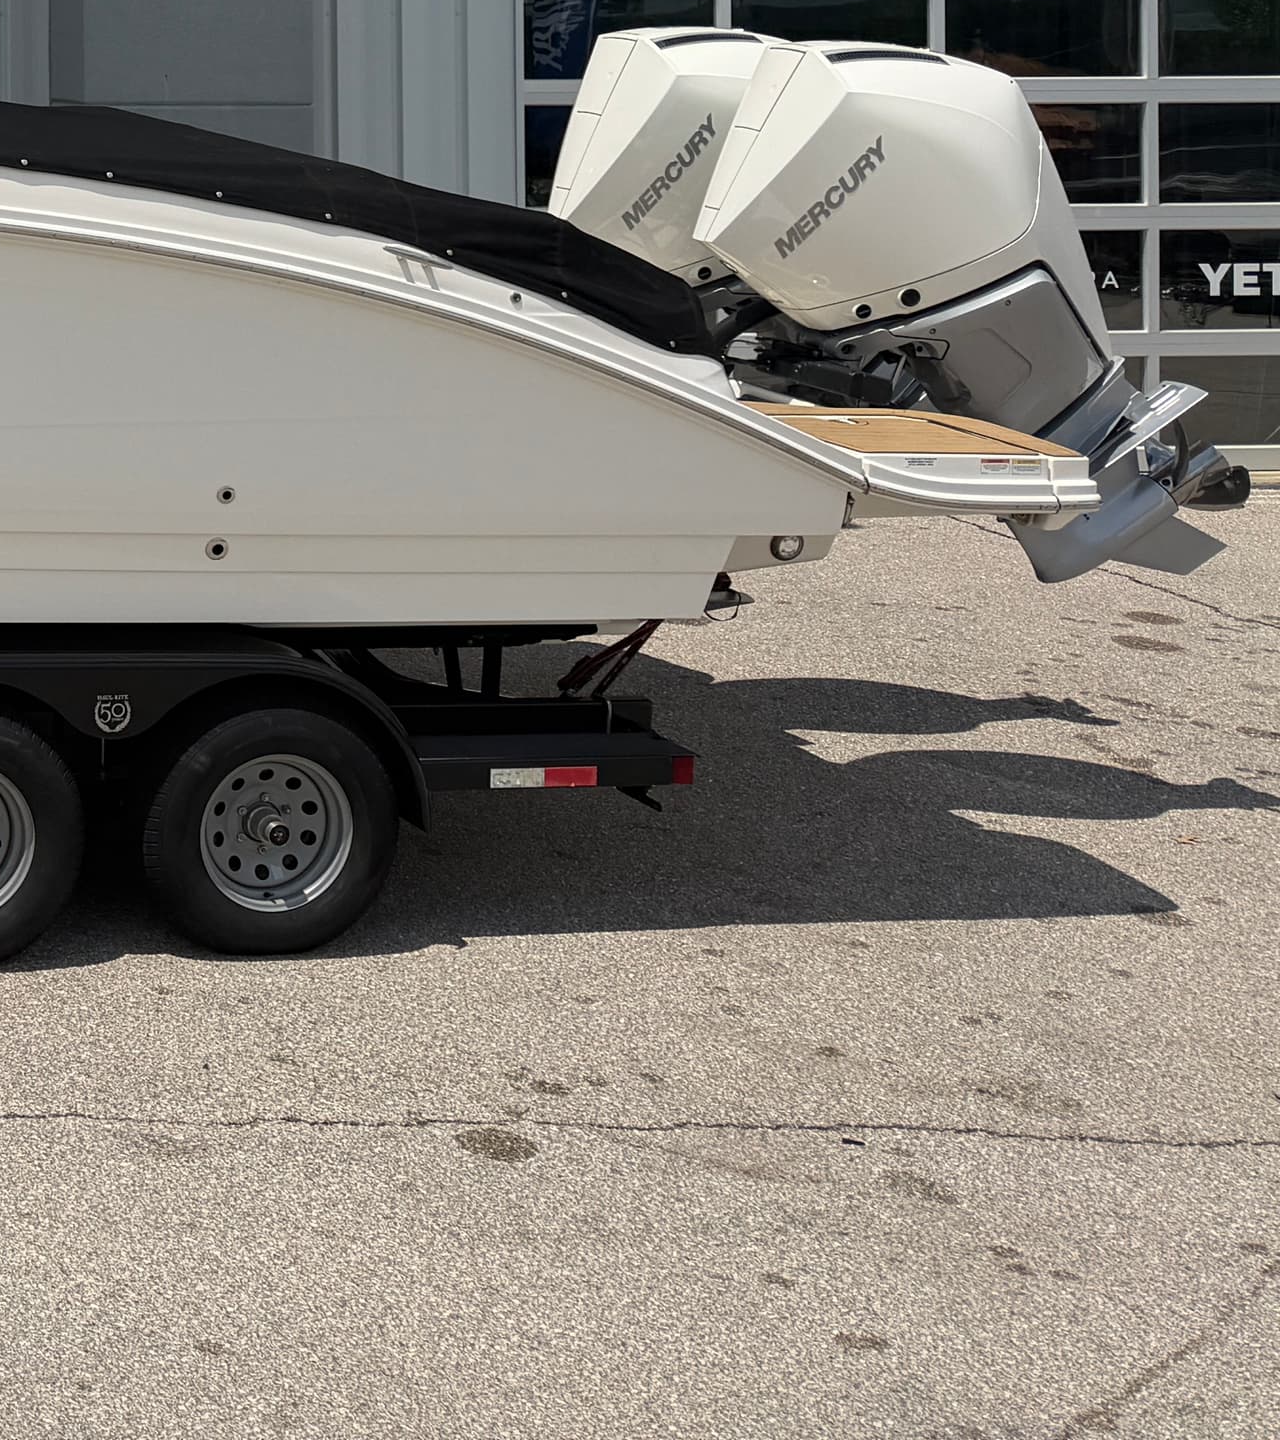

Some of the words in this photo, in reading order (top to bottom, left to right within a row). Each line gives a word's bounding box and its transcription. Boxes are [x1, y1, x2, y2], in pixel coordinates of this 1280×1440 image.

[621, 113, 717, 231] MERCURY
[774, 135, 886, 259] MERCURY
[100, 702, 126, 724] 50
